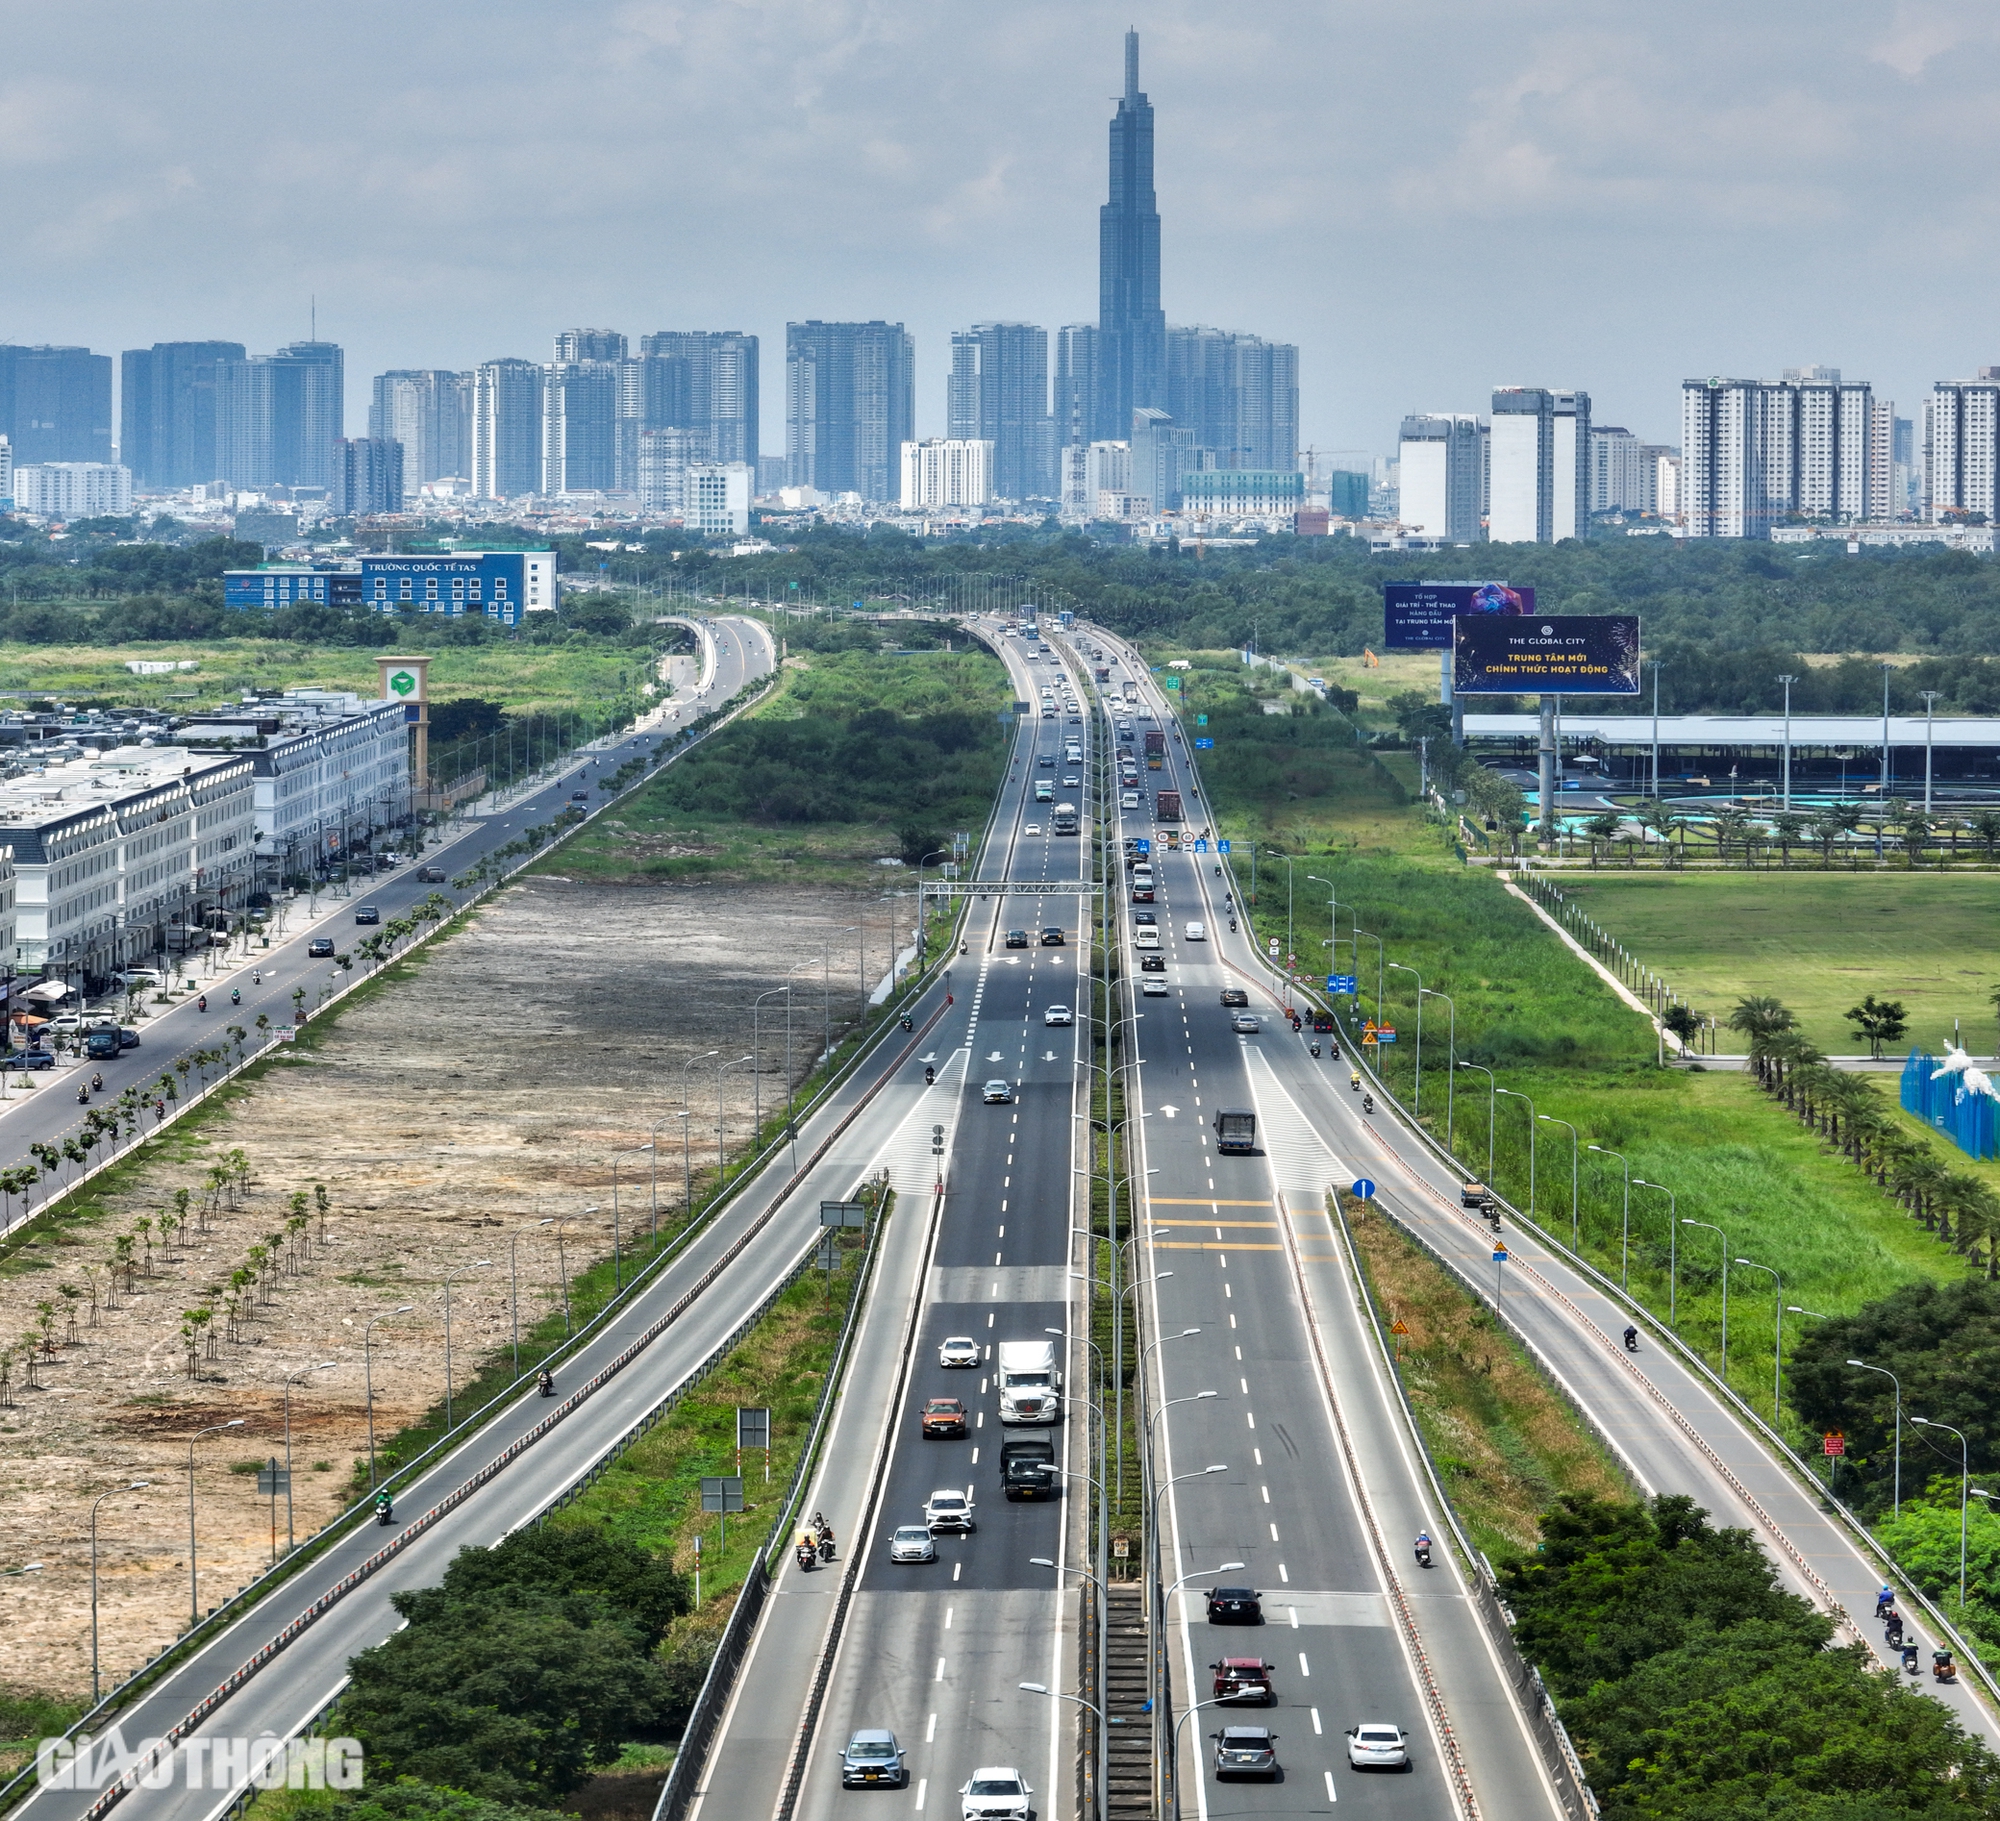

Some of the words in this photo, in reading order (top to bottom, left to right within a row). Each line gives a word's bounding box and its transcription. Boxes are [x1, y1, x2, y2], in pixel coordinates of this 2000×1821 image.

[368, 562, 410, 572] TRƯỜNG
[412, 562, 441, 572] QUỐC
[444, 562, 457, 571] TẾ
[1508, 654, 1542, 662] TRUNG
[1545, 652, 1565, 662] TÂM
[1568, 653, 1587, 662] MỚI
[1486, 664, 1517, 673] CHÍNH
[1521, 664, 1547, 673] THỨC
[1551, 666, 1577, 675] HOẠT
[1580, 664, 1608, 675] ĐỘNG
